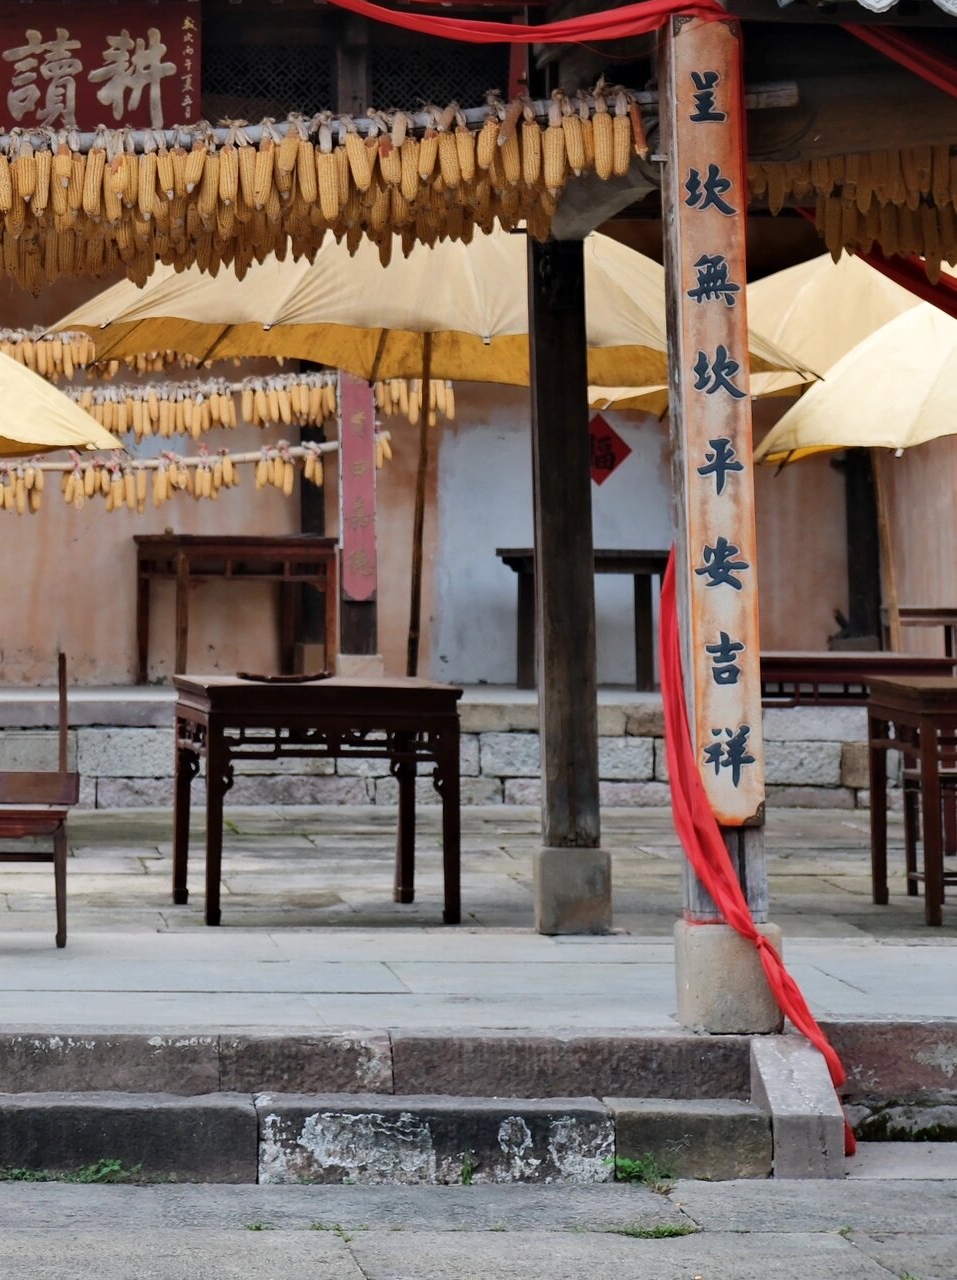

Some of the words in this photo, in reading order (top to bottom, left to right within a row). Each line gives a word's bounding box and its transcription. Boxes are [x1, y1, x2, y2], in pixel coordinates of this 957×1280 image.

[683, 70, 756, 788] 呈坎無坎平安吉祥
